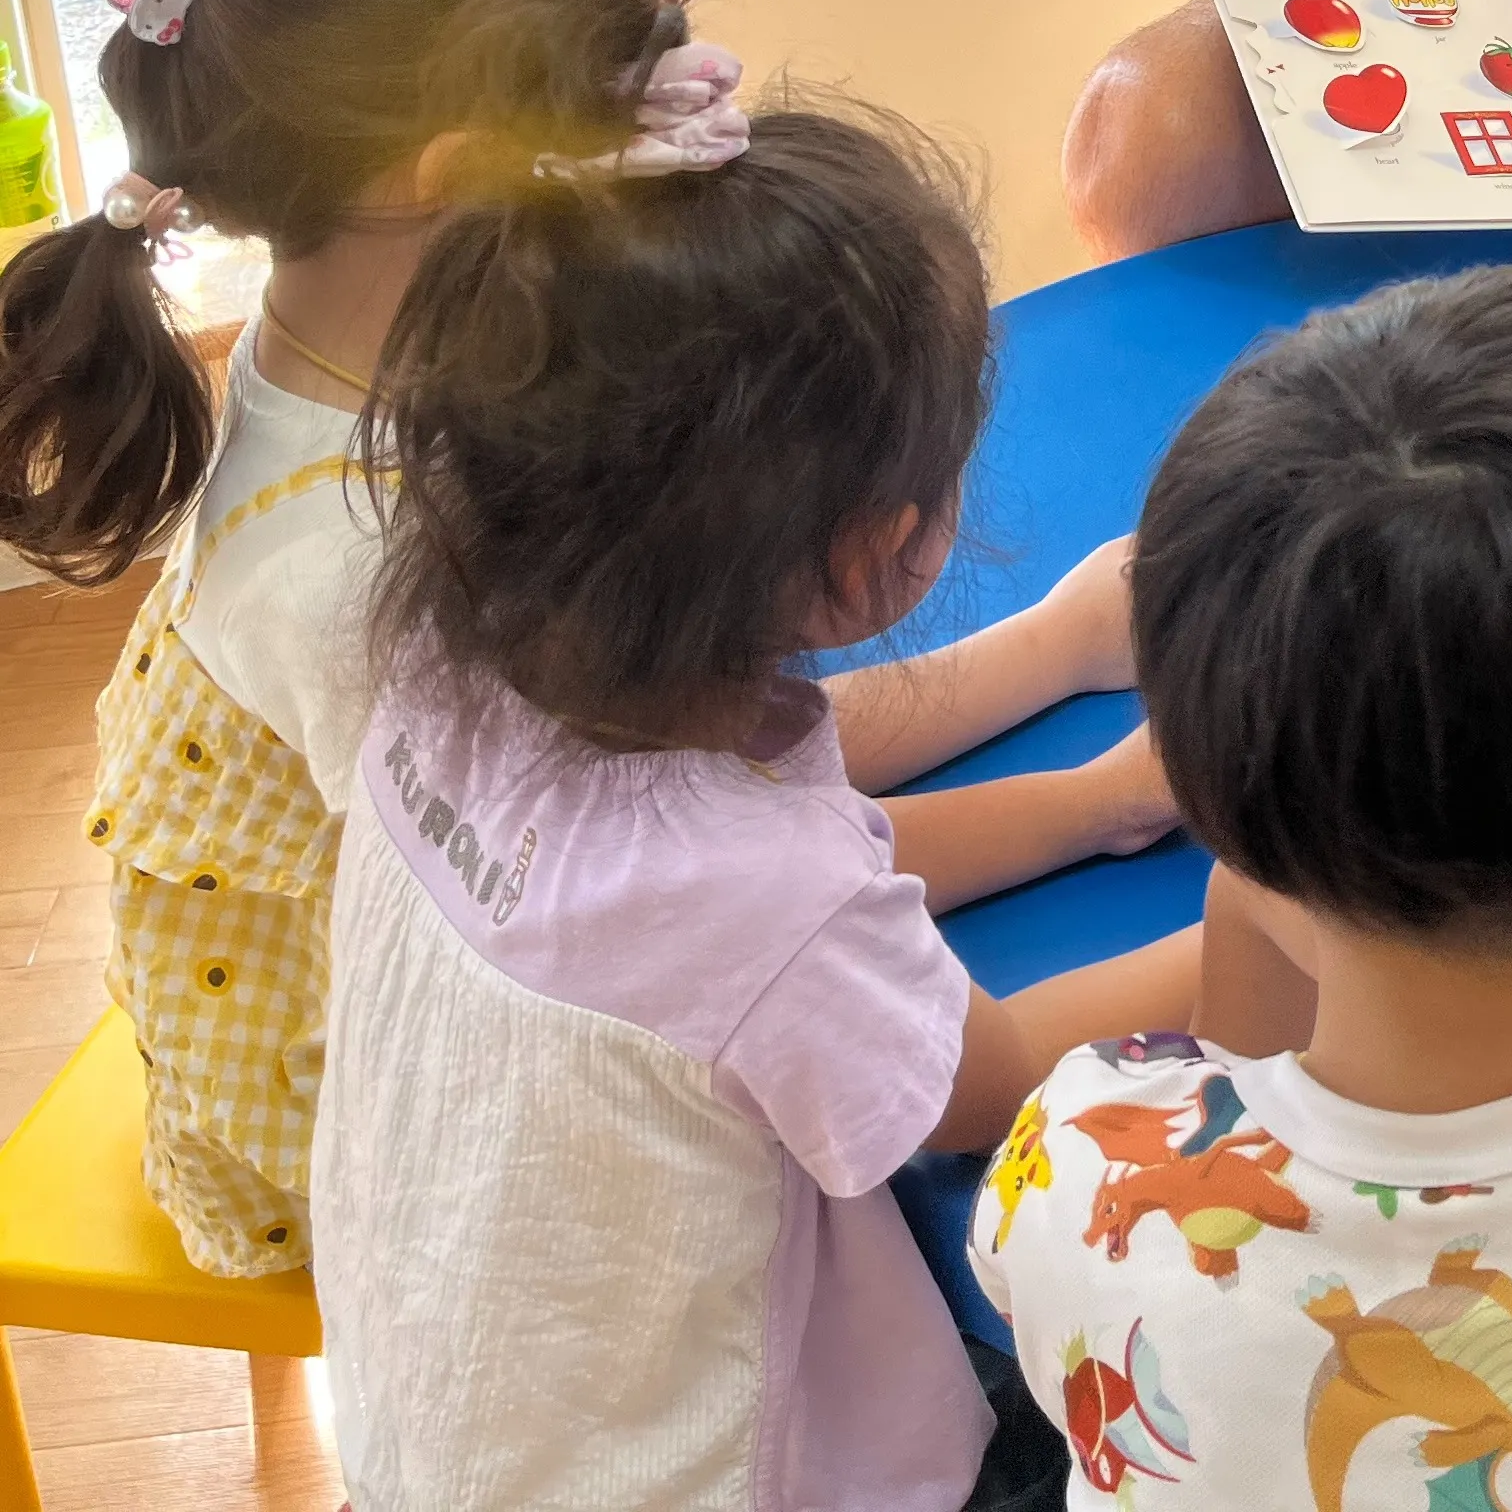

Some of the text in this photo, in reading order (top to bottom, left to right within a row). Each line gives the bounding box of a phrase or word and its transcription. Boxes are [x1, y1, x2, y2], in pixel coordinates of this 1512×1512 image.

[1434, 36, 1446, 44] jar
[1333, 61, 1358, 70] apple
[1375, 156, 1400, 165] heart
